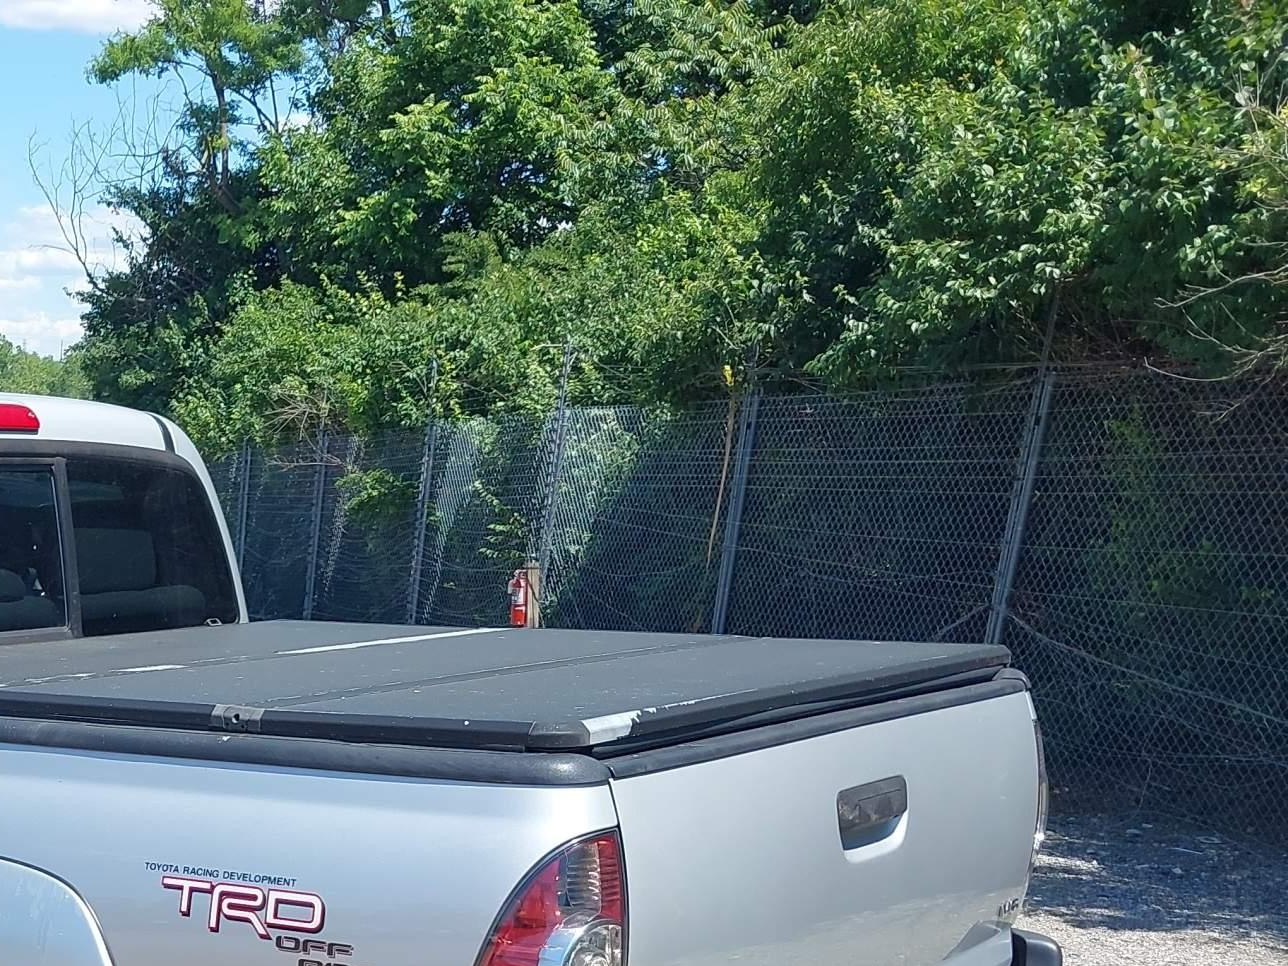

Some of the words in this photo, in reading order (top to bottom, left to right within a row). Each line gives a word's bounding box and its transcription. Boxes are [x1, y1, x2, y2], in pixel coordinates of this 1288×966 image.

[144, 862, 179, 874] TOYOTA
[182, 866, 219, 879] RACING
[222, 871, 297, 888] DEVELOPMENT
[161, 875, 326, 940] TRD
[274, 935, 354, 958] OFF
